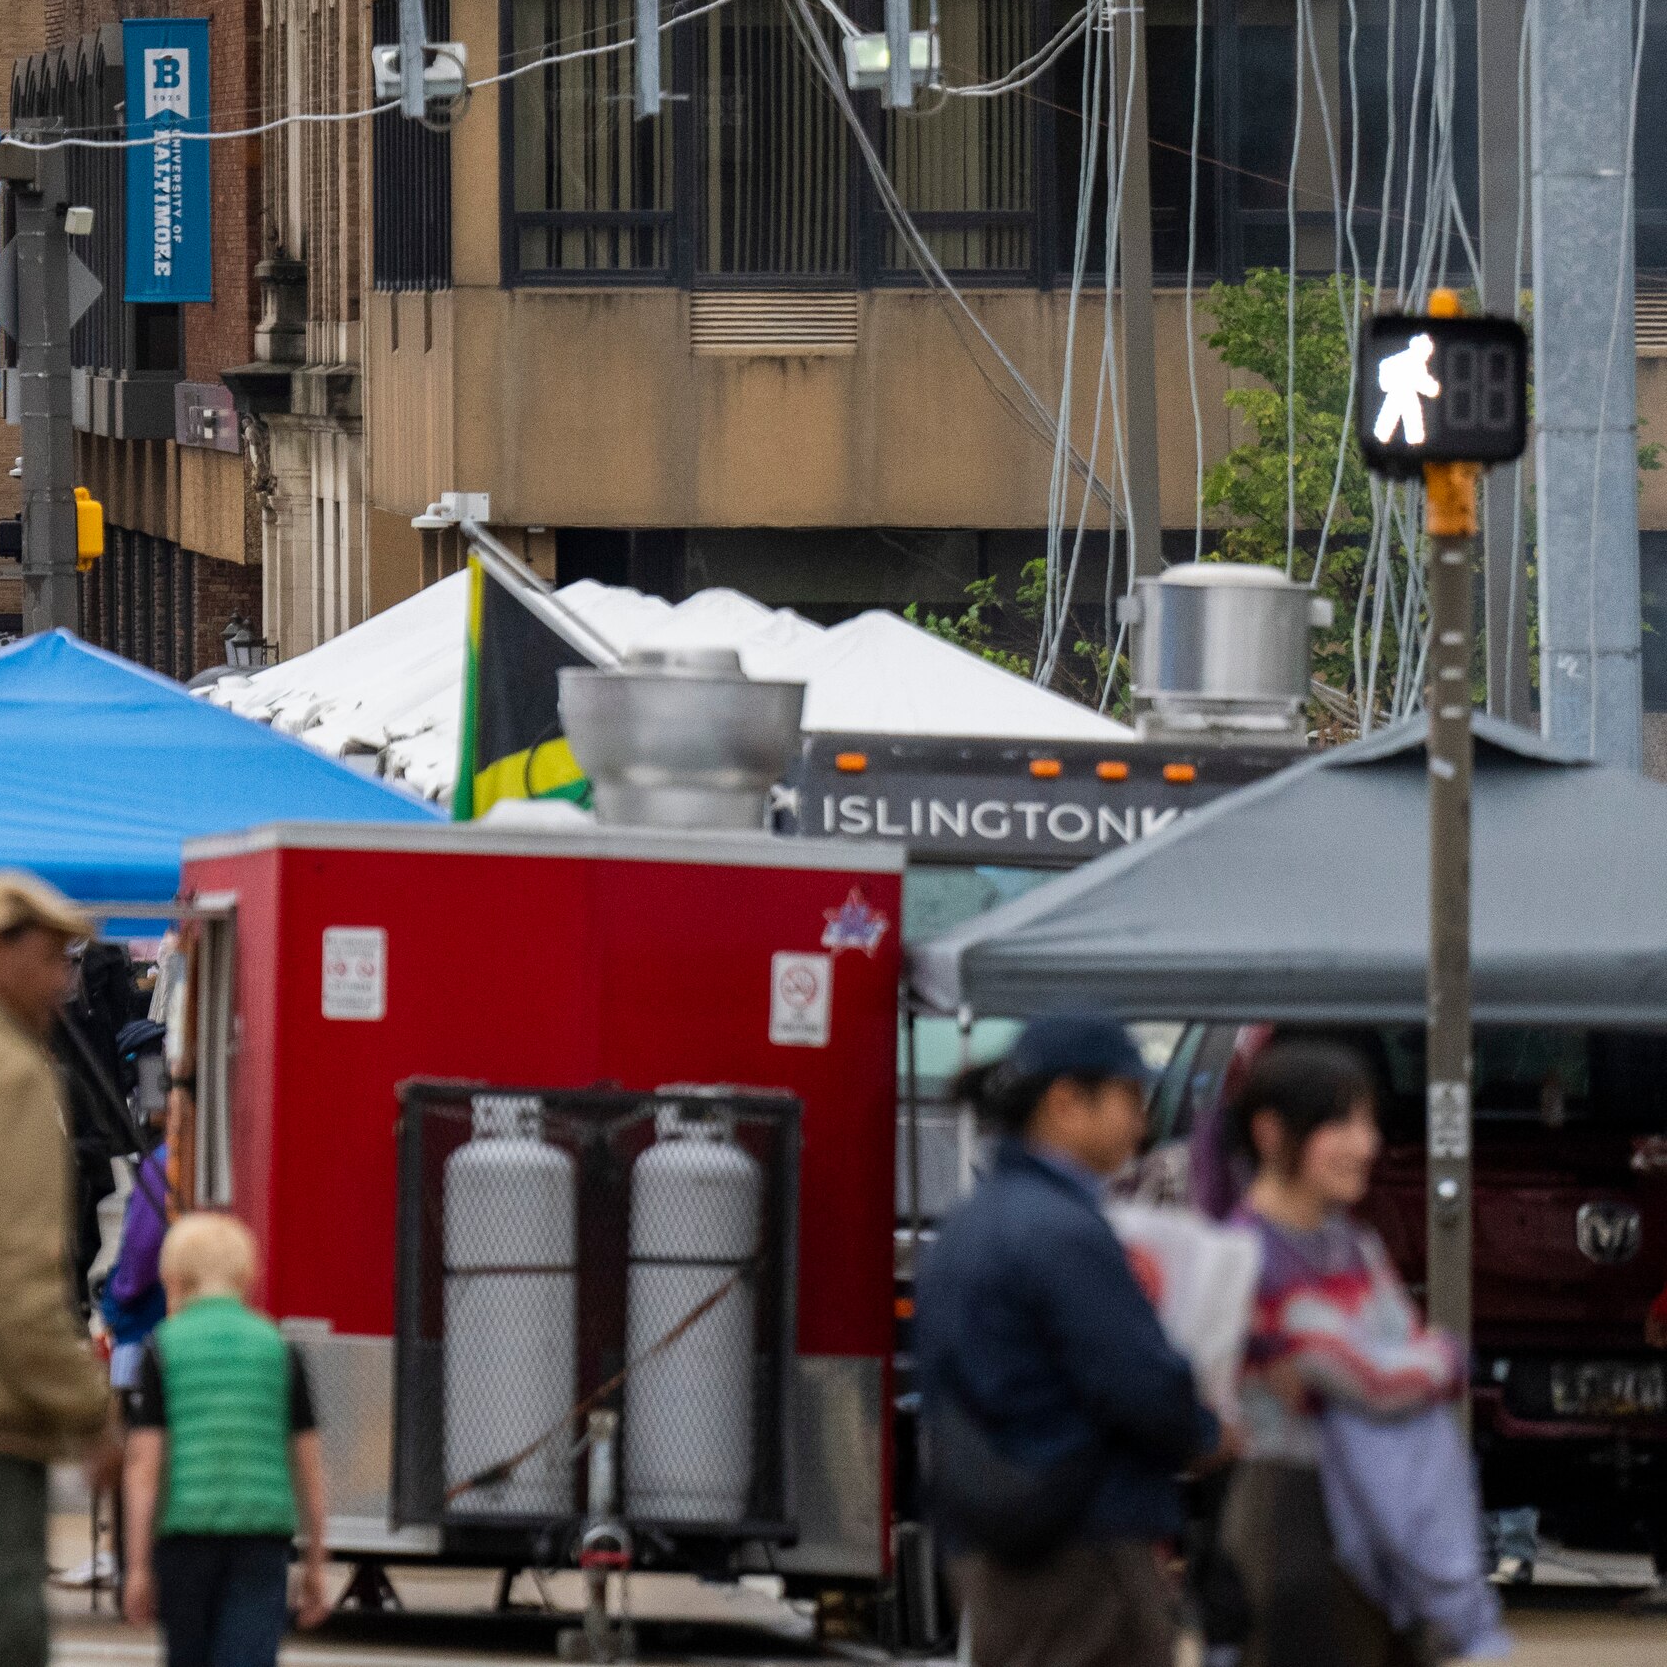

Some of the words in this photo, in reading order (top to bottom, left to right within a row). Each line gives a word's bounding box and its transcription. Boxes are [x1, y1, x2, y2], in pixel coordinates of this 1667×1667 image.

[153, 57, 181, 89] B
[172, 129, 182, 216] UNIVERSITY
[153, 130, 173, 277] BALTIMORE
[173, 225, 182, 244] OF
